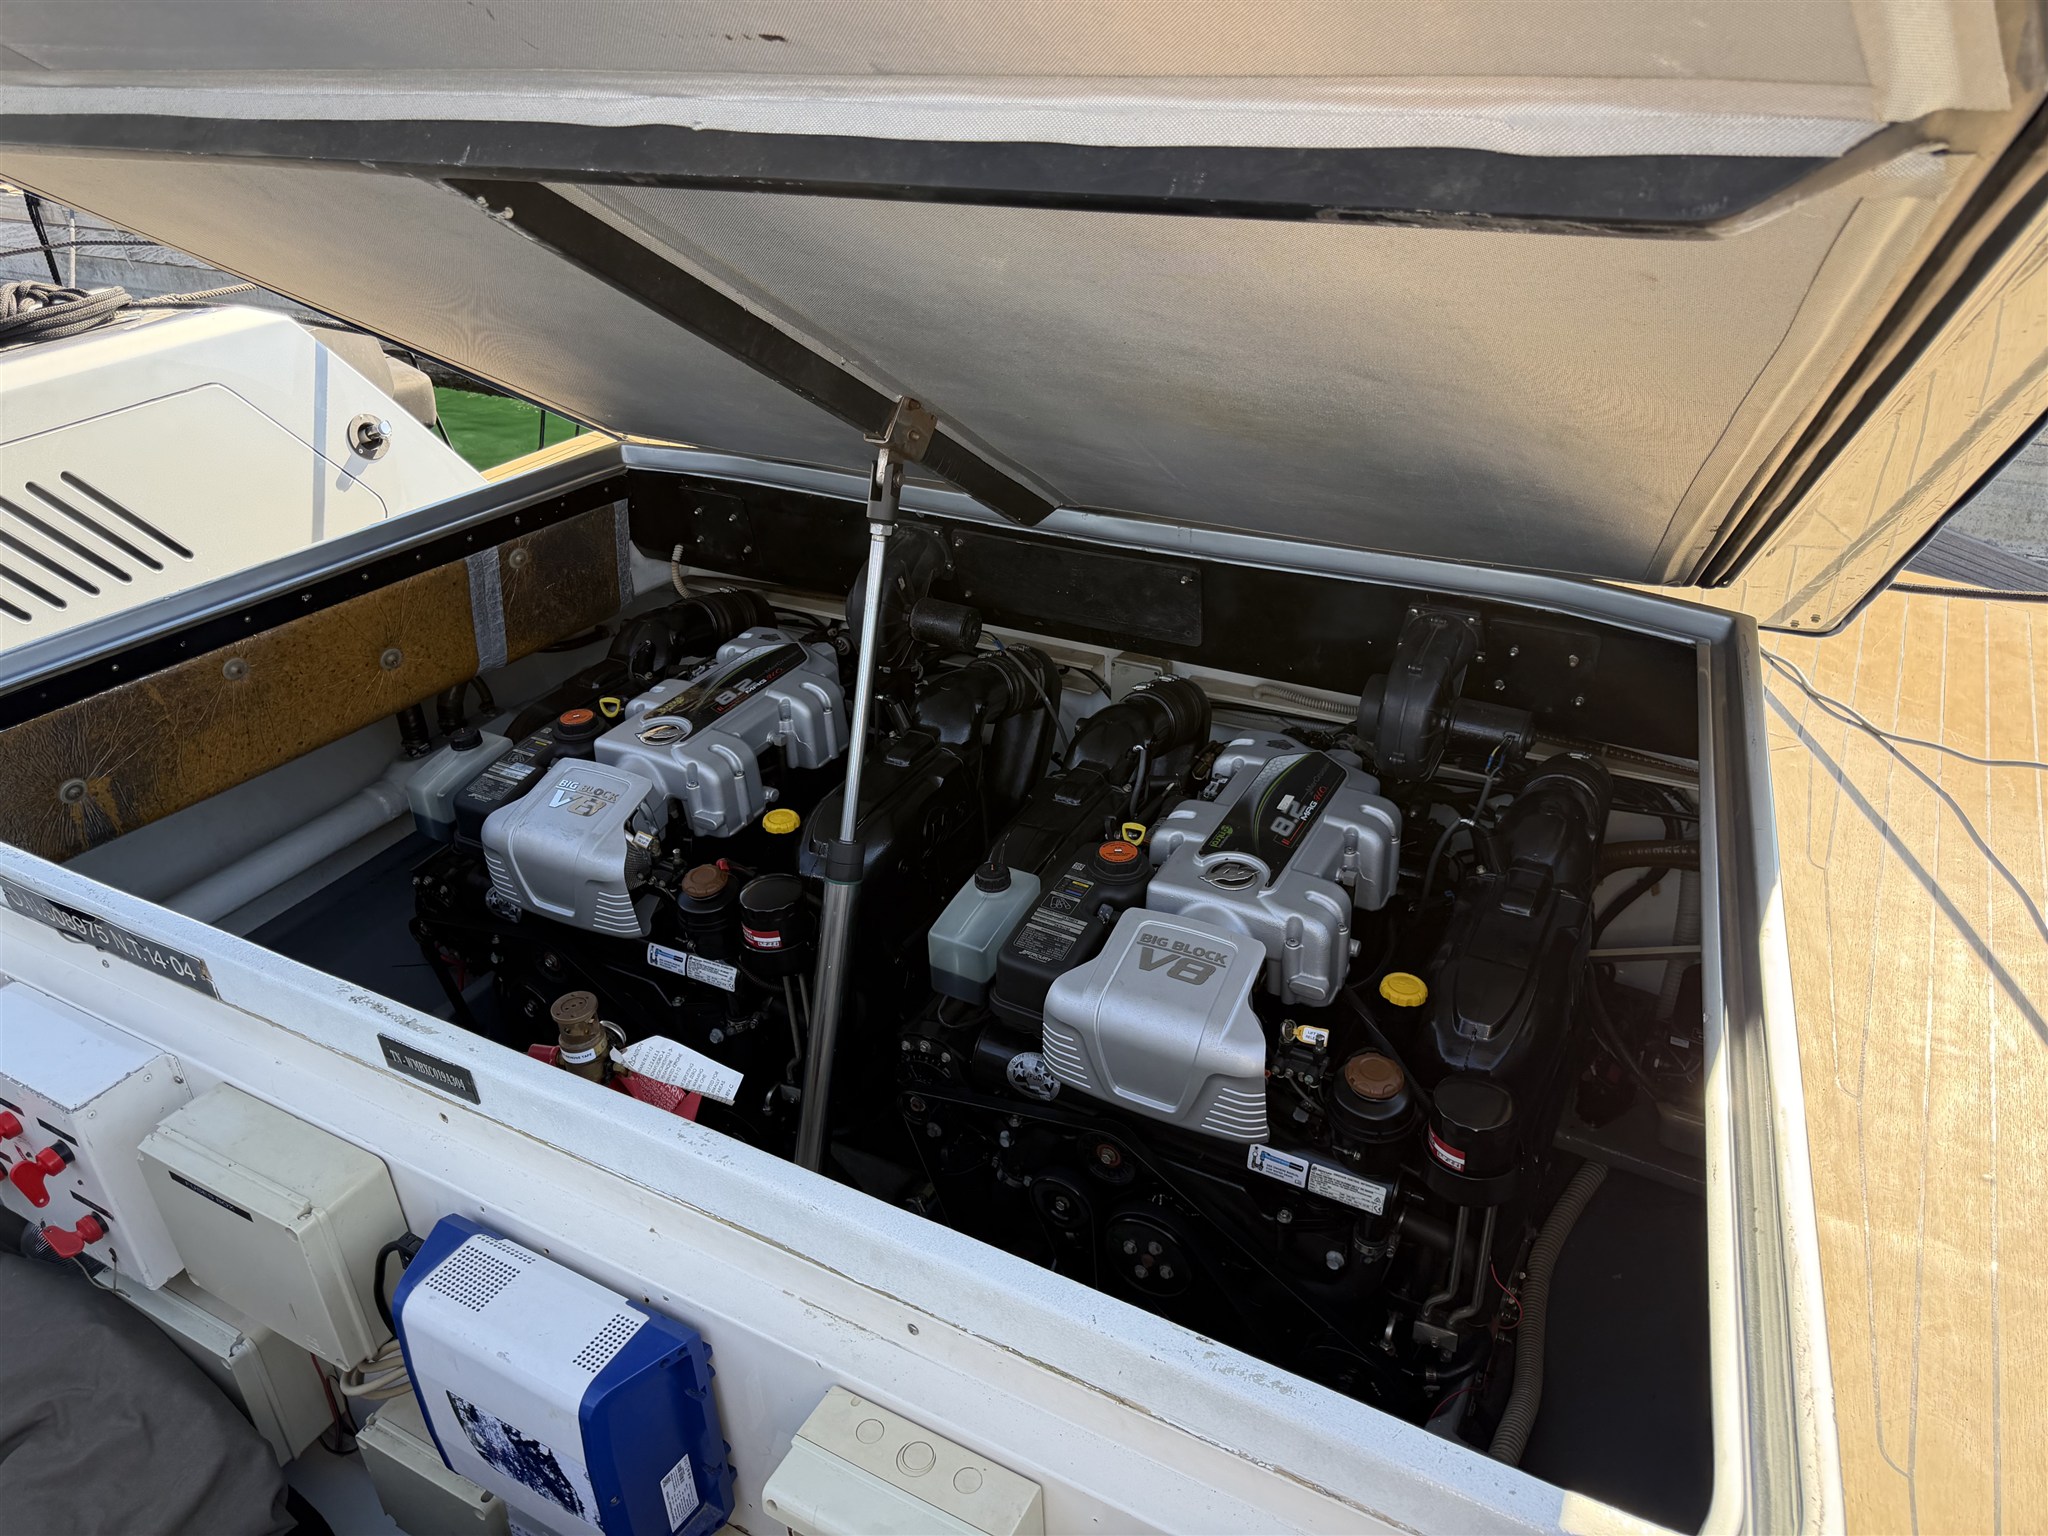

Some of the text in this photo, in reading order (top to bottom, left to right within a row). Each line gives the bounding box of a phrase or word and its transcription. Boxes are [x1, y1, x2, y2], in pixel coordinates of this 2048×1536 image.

[548, 789, 607, 817] V8
[558, 779, 620, 801] BIG BLOCK
[1300, 800, 1318, 821] MAG
[1140, 933, 1228, 964] BIG BLOCK
[1139, 946, 1216, 985] V8
